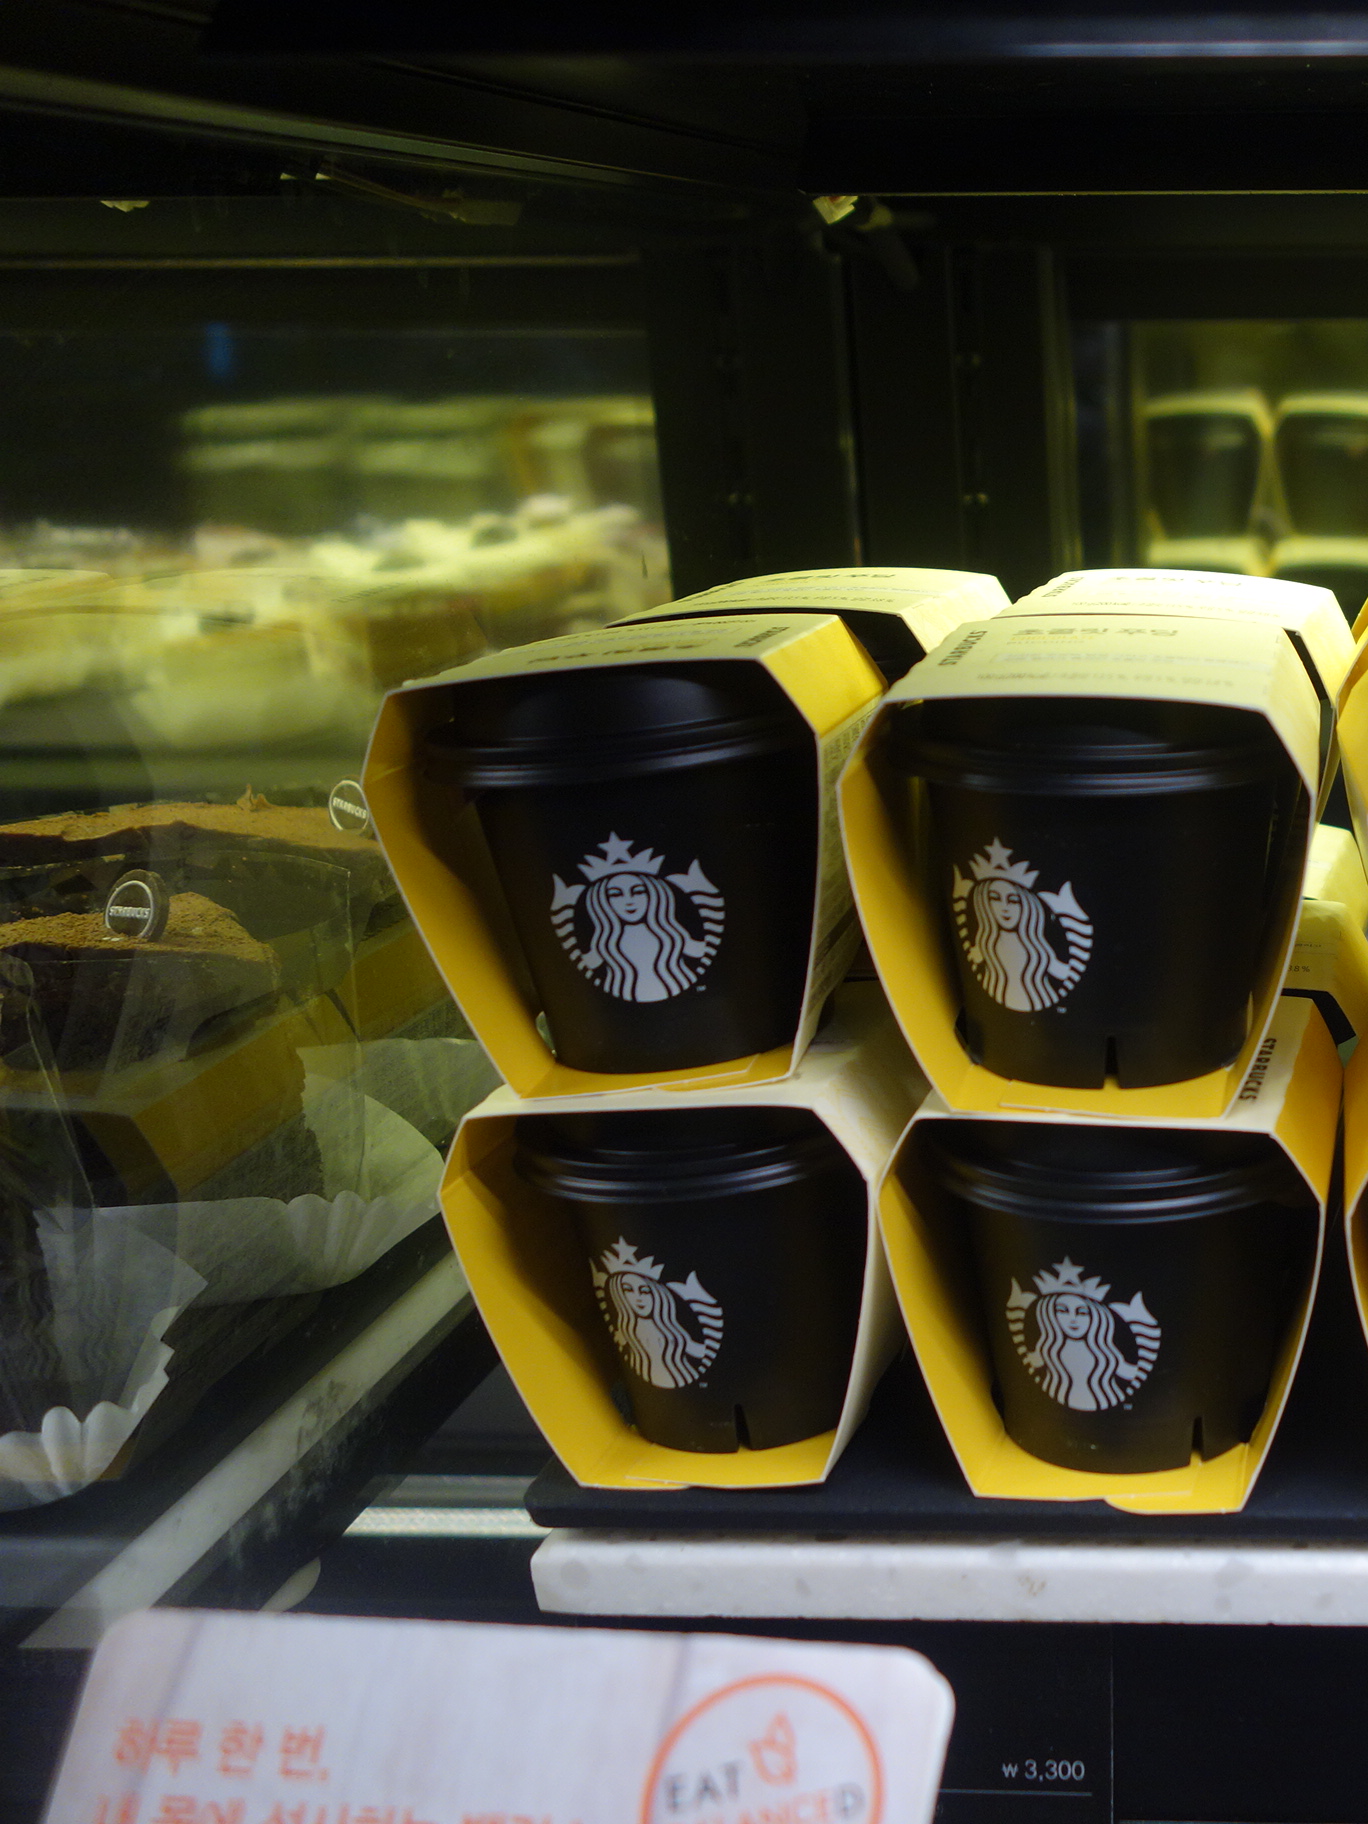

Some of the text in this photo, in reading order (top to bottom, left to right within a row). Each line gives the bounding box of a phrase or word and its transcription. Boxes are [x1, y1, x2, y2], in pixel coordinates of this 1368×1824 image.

[112, 1717, 202, 1777] 하루
[217, 1719, 264, 1779] 한
[1024, 1759, 1085, 1782] 3,300
[663, 1760, 743, 1814] EAT
